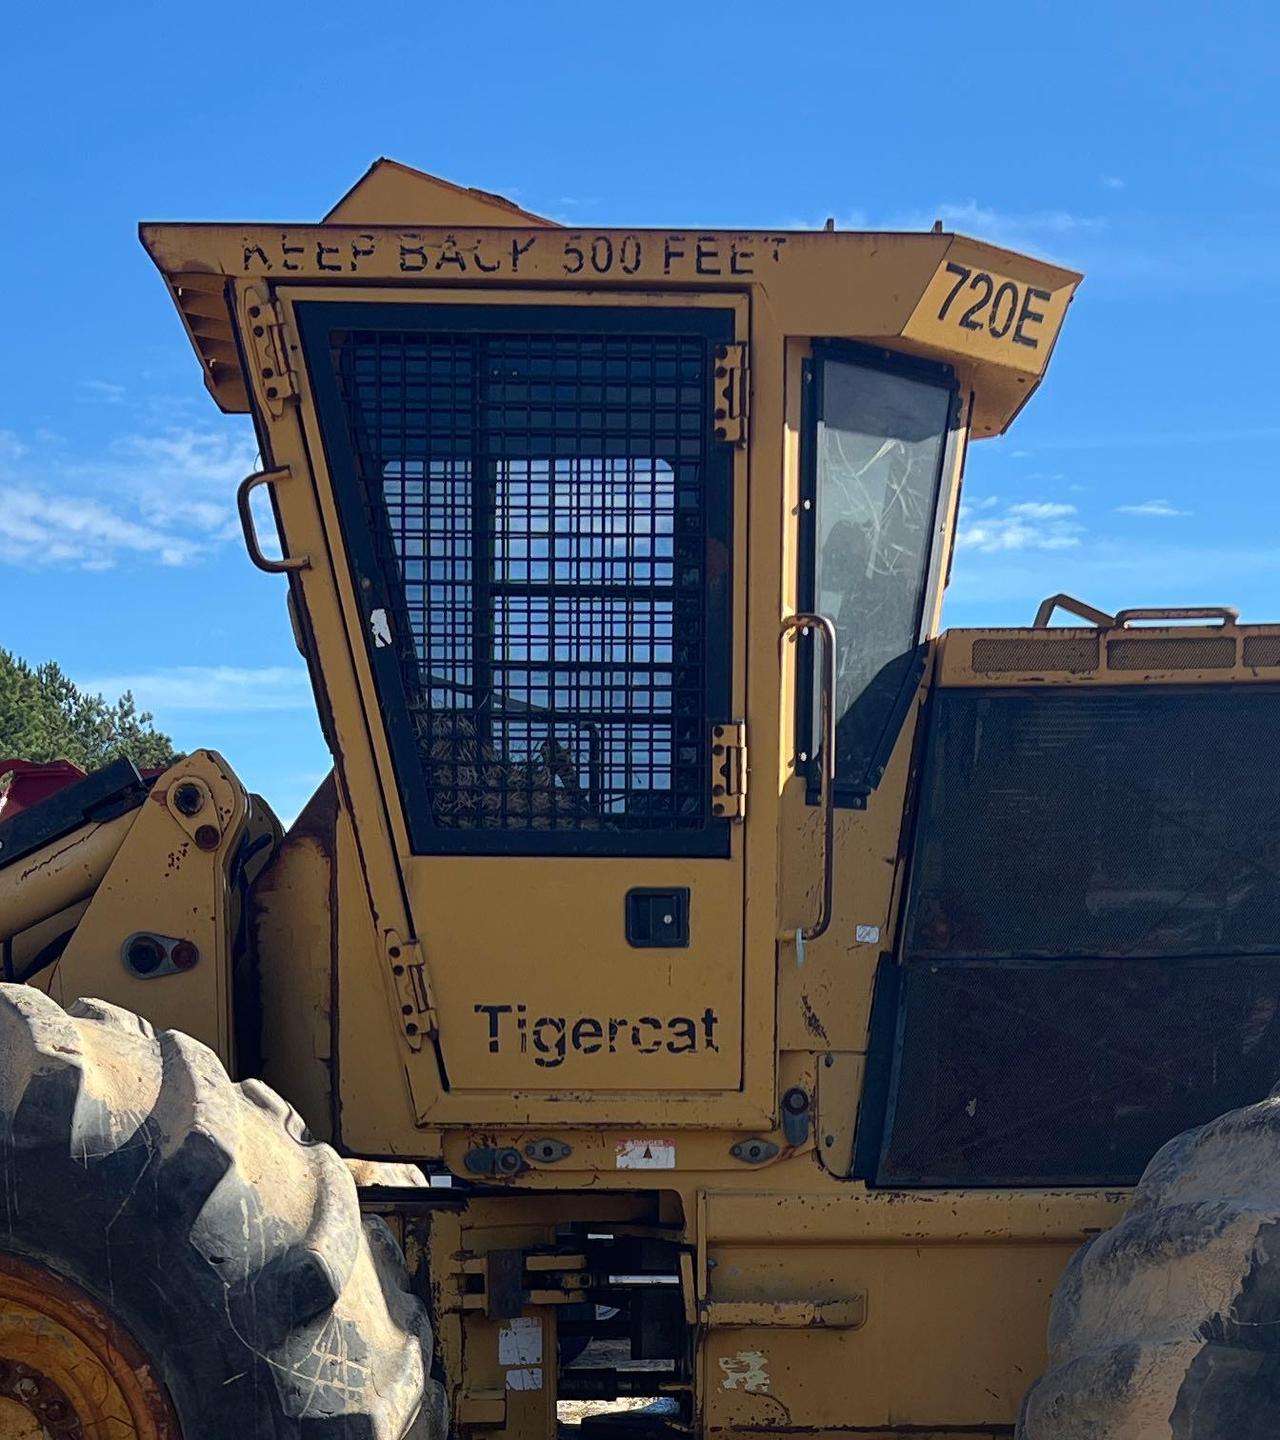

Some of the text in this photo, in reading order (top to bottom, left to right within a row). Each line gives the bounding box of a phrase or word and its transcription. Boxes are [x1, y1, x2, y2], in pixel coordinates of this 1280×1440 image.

[243, 230, 787, 276] KEEP BACK 500 FEET
[937, 261, 1053, 349] 720E
[473, 1003, 720, 1068] Tigercat
